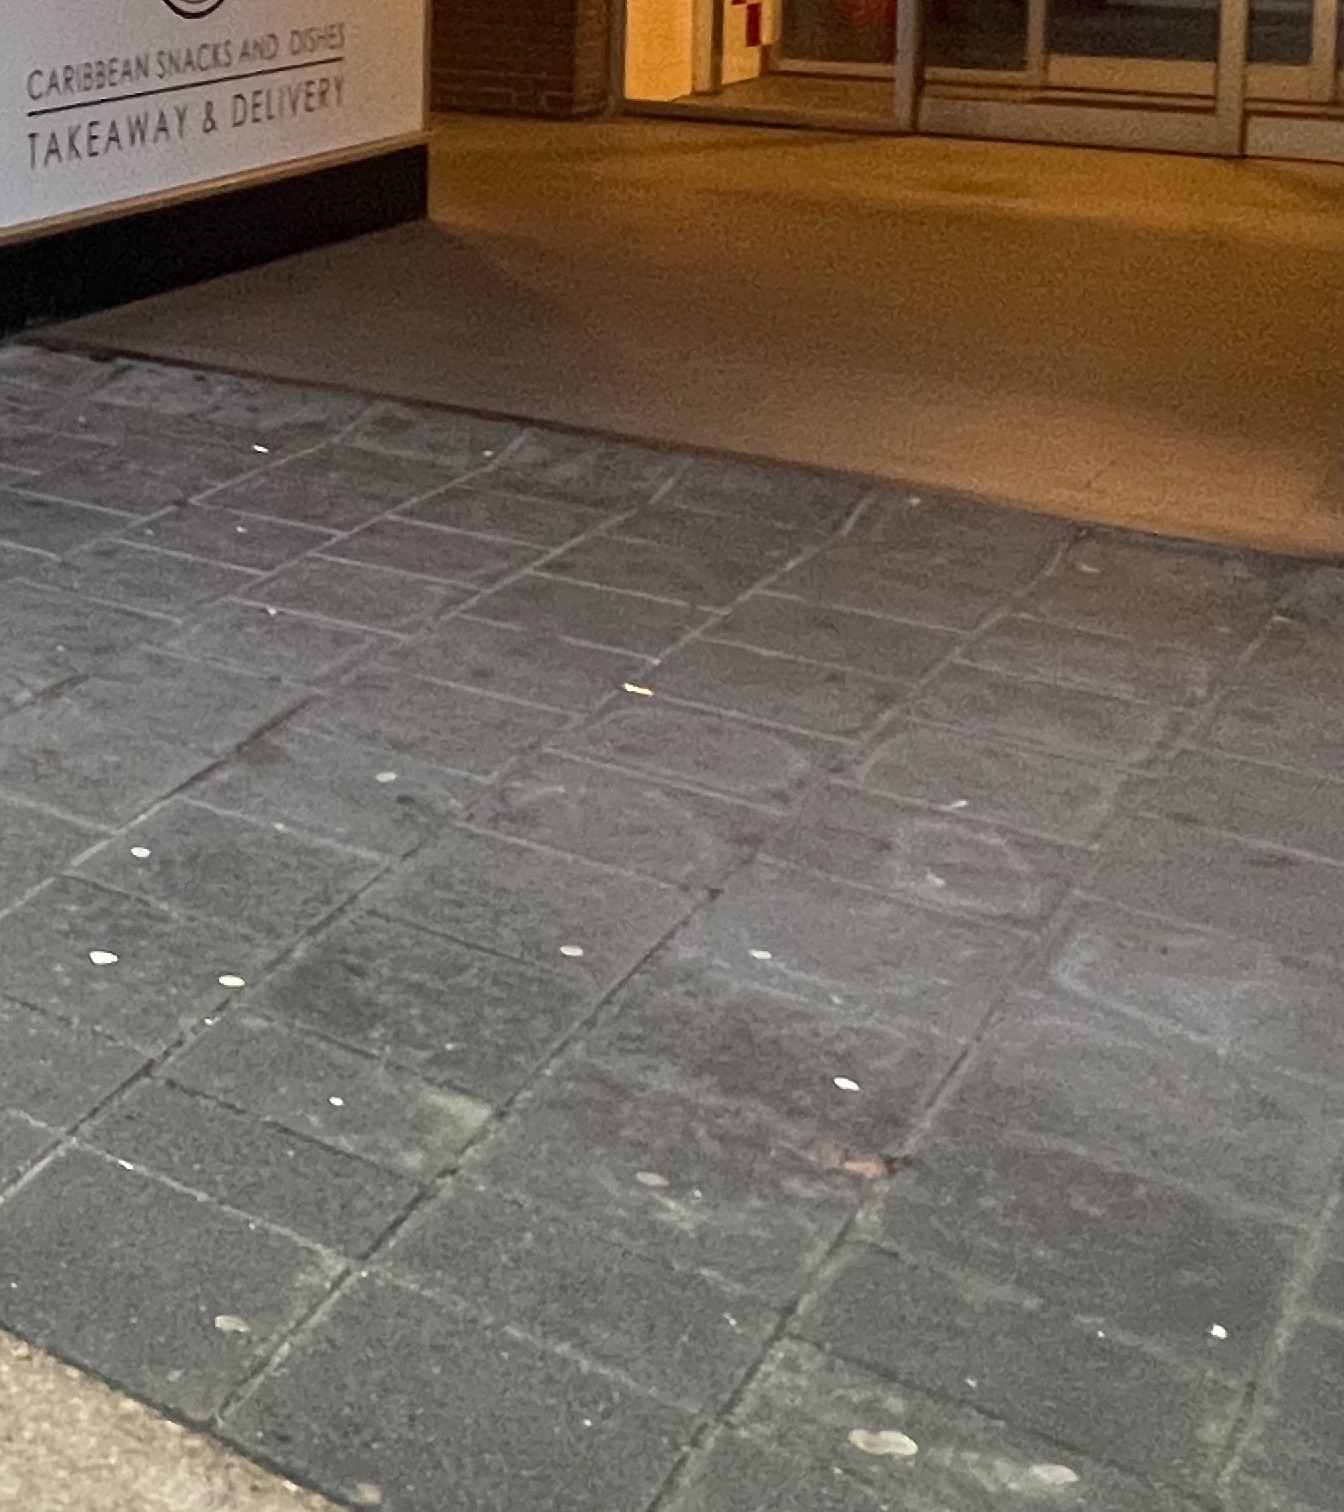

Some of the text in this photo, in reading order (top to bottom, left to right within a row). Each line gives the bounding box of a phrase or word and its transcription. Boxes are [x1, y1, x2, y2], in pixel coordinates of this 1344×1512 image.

[26, 22, 345, 101] CARIBBEAN SNACKS AND DISHES
[27, 77, 343, 169] TAKEAWAY & DELIVERY
